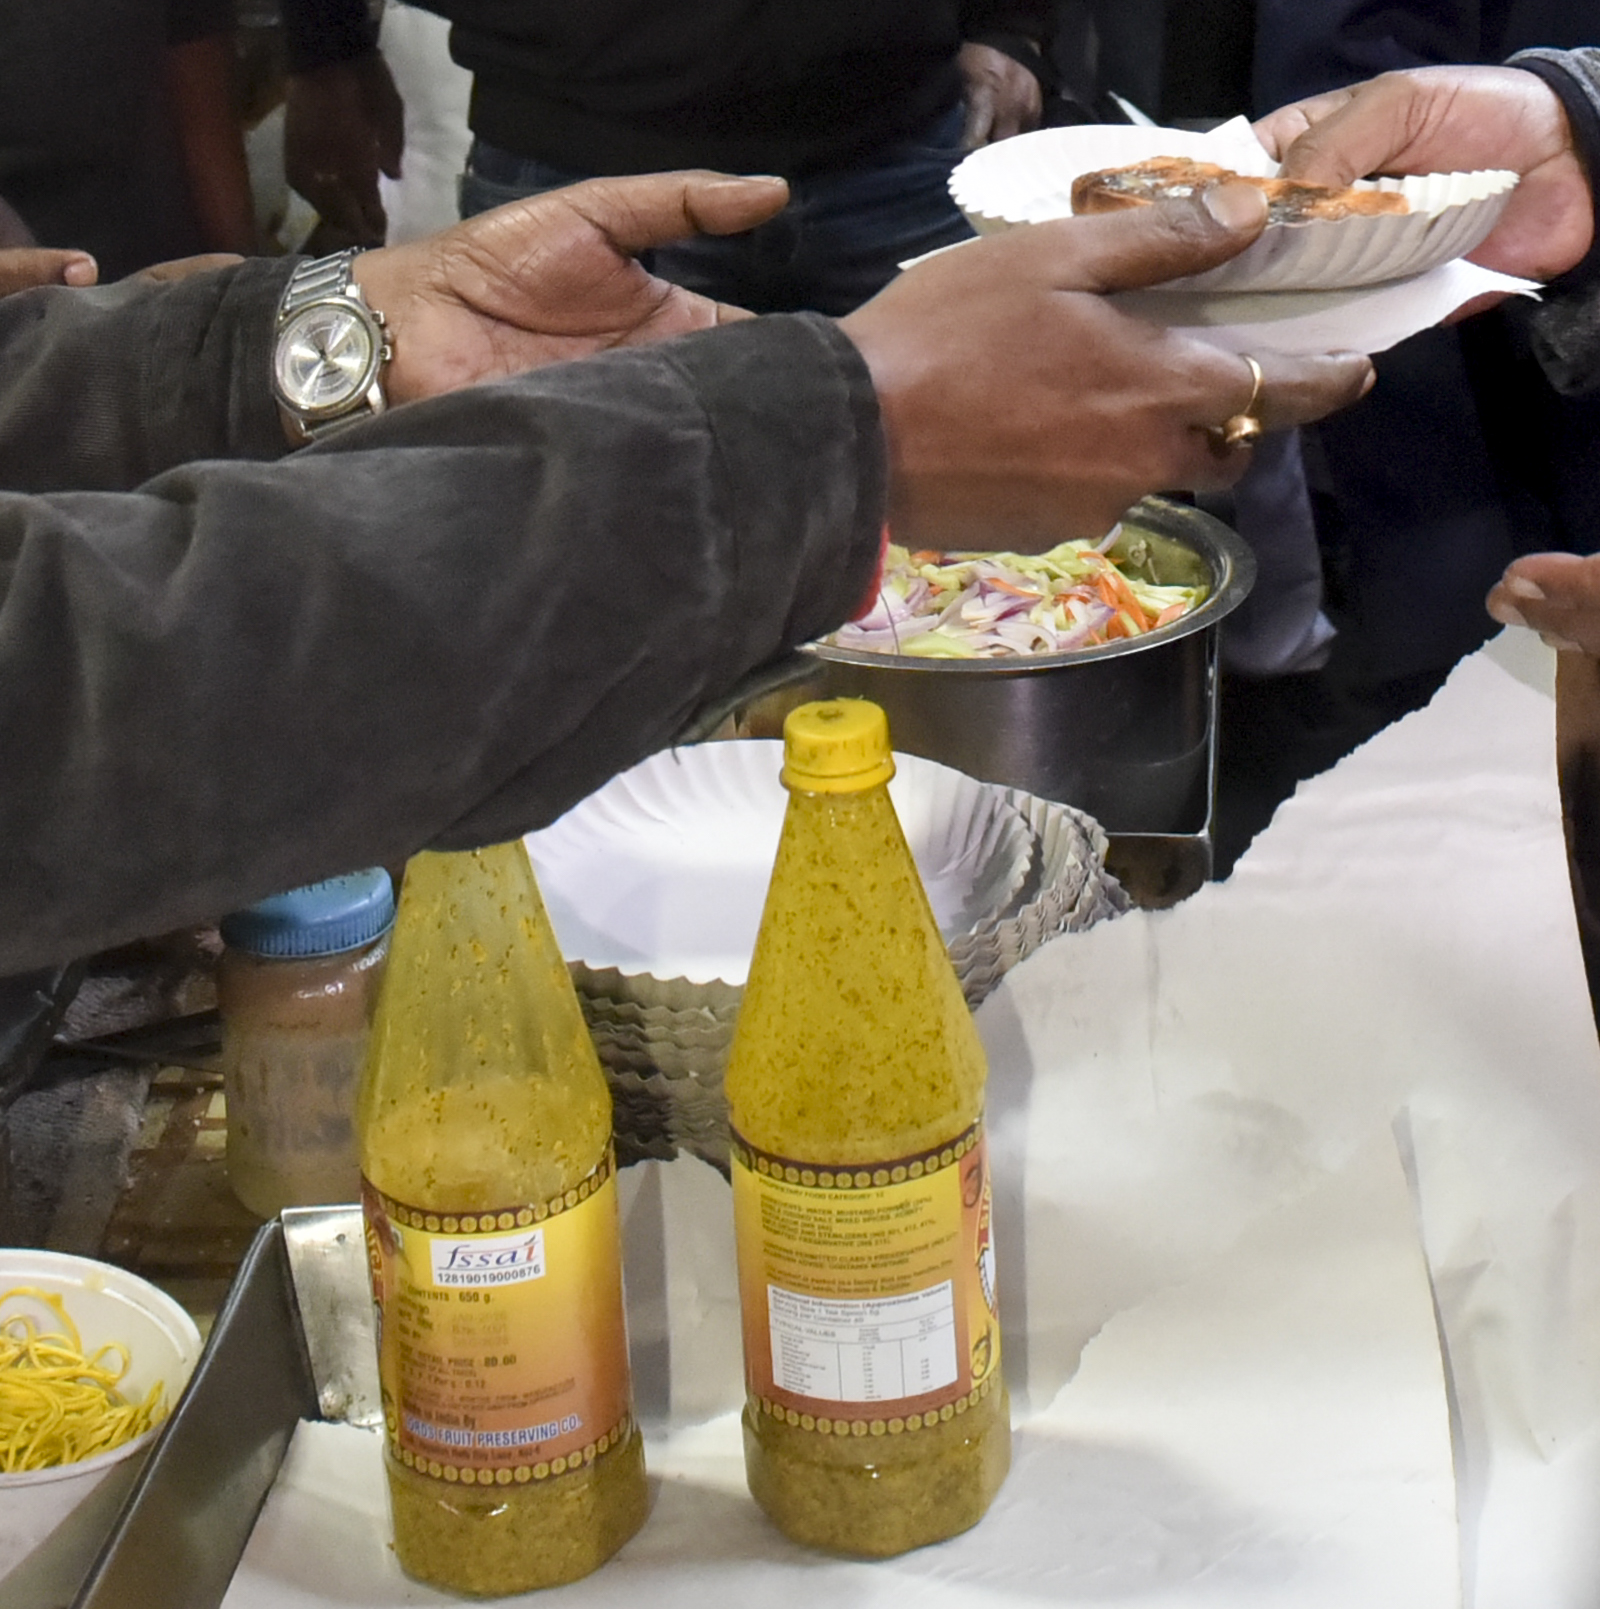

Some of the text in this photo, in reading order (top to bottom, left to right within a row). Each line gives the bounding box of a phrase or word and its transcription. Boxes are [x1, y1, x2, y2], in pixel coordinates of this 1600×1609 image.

[439, 1234, 542, 1271] fssai
[437, 1264, 542, 1285] 12819019000876
[437, 1429, 473, 1446] FRUIT
[477, 1421, 558, 1447] PRESERVING
